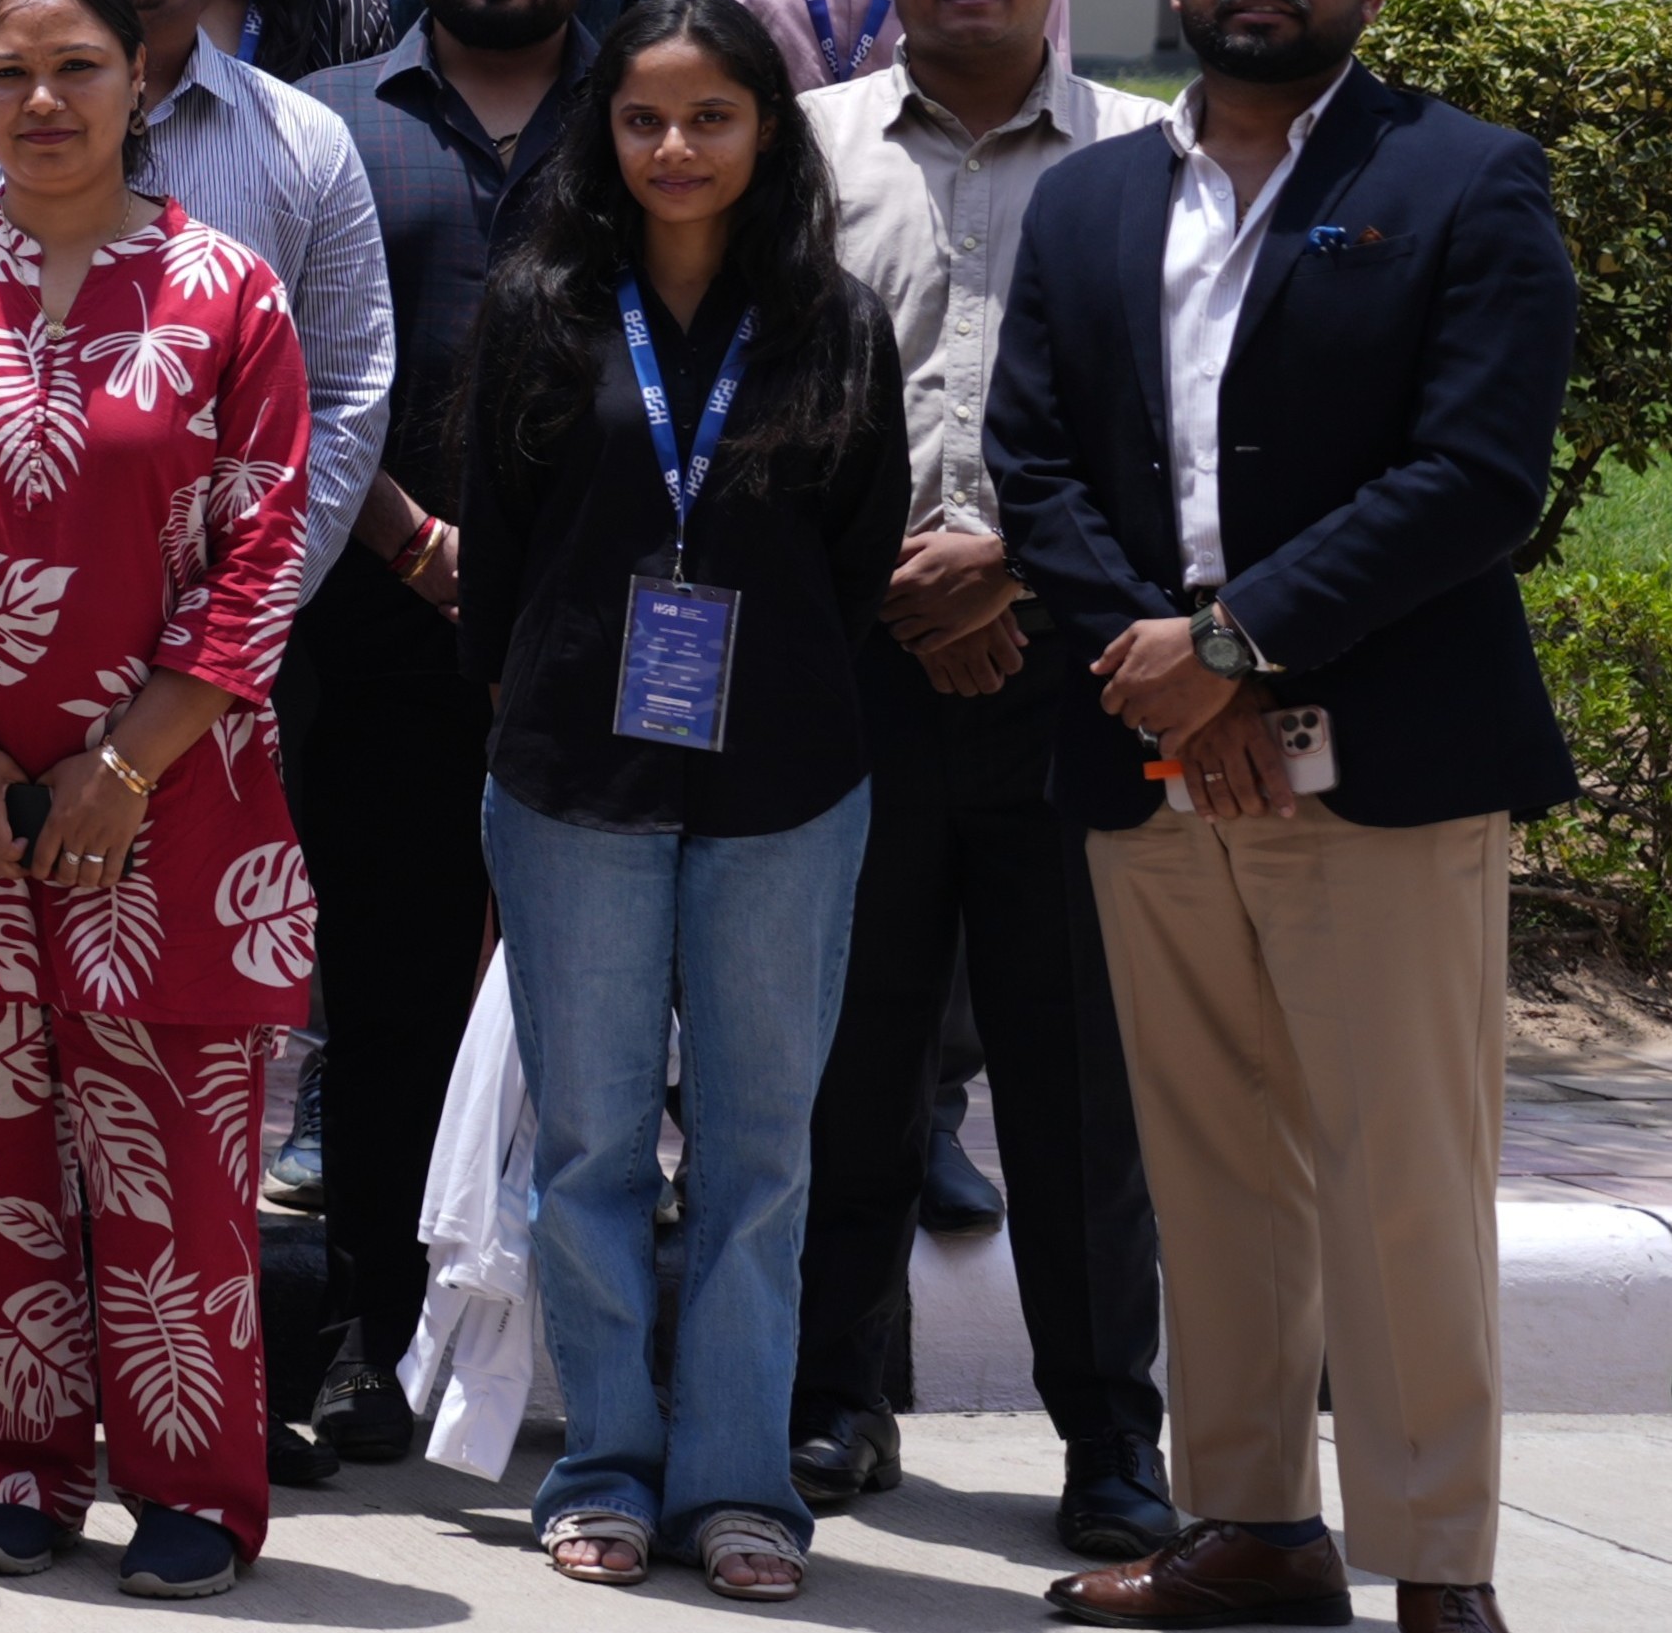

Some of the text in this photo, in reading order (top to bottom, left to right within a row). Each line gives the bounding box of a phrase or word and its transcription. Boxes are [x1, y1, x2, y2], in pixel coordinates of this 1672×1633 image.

[821, 38, 839, 73] HSB
[851, 34, 874, 69] HSB
[623, 309, 649, 347] HSB
[642, 385, 669, 426] HSB
[709, 377, 738, 415] HSB
[664, 469, 682, 512] HSB
[686, 455, 711, 498] HSB
[653, 602, 679, 617] HSB
